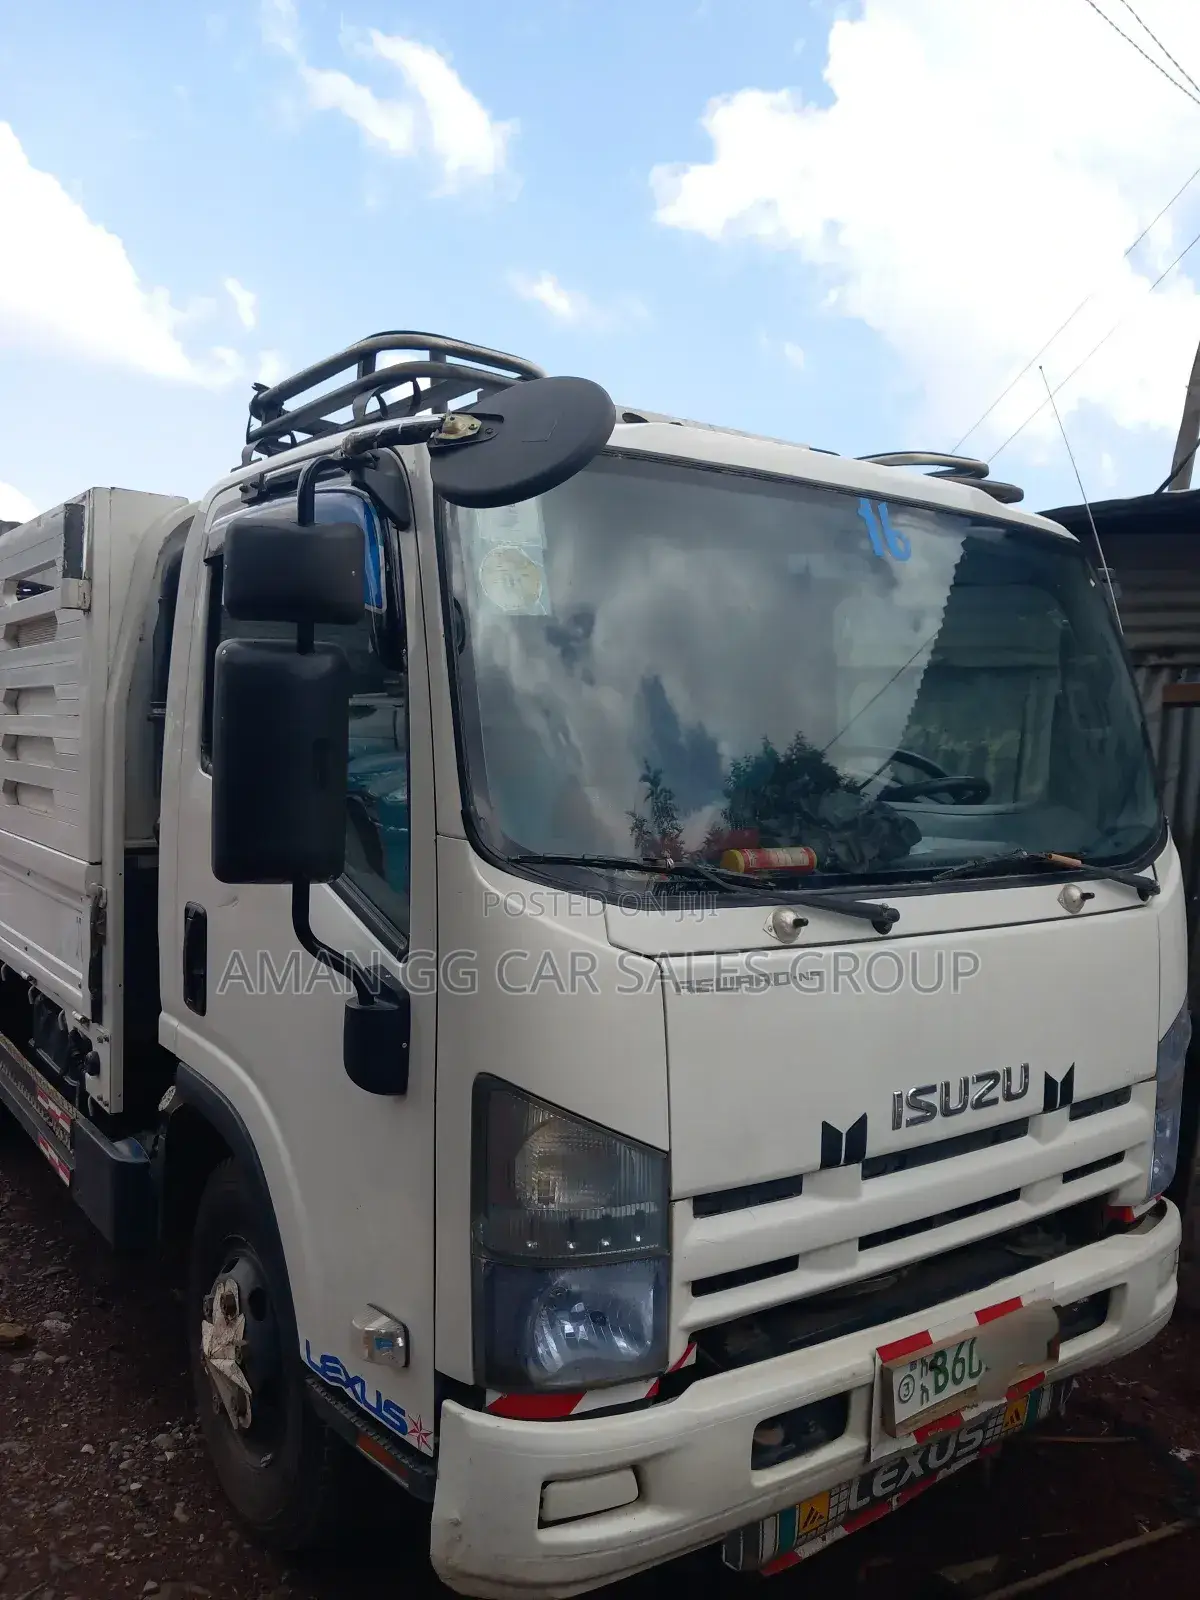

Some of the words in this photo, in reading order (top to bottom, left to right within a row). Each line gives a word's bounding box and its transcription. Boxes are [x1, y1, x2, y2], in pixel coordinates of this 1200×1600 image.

[892, 1062, 1029, 1131] ISUZU
[305, 1338, 408, 1436] LEXUS
[849, 1424, 986, 1511] LEXUS
